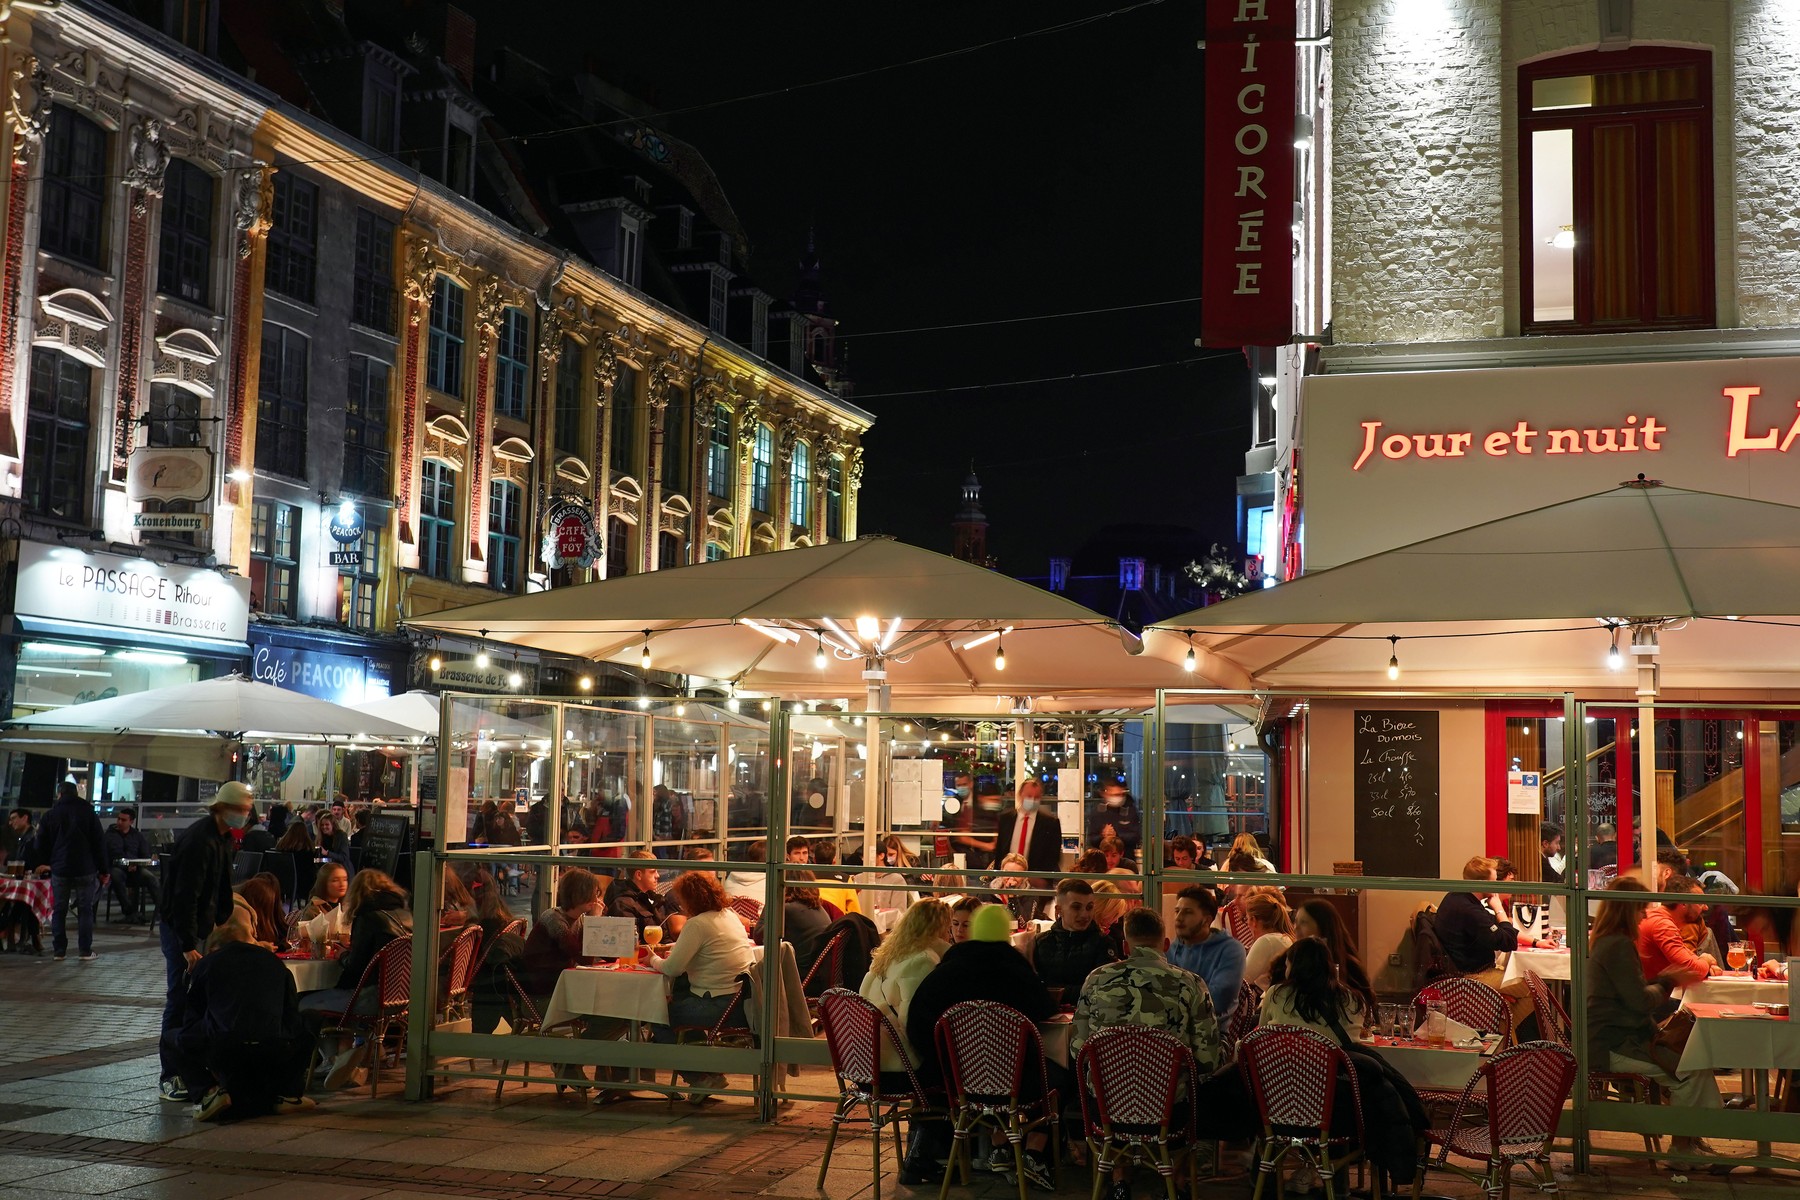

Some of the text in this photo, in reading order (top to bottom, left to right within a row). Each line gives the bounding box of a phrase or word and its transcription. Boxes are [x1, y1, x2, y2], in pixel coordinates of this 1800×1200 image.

[1723, 386, 1800, 458] L
[1352, 415, 1667, 471] Jour et nuit
[133, 514, 202, 529] Kronenbourg
[554, 506, 590, 525] BRASSERIE
[332, 525, 361, 537] PEACOCK
[562, 543, 582, 552] FOY
[334, 553, 359, 564] BAR
[59, 565, 213, 607] Le PASSAGE Rihour
[172, 611, 227, 633] Brasserie
[254, 647, 287, 687] Café
[291, 661, 361, 689] PEACOCK
[439, 667, 482, 684] Brasserie
[485, 673, 496, 685] de
[1359, 715, 1378, 734] La
[1360, 749, 1373, 765] La
